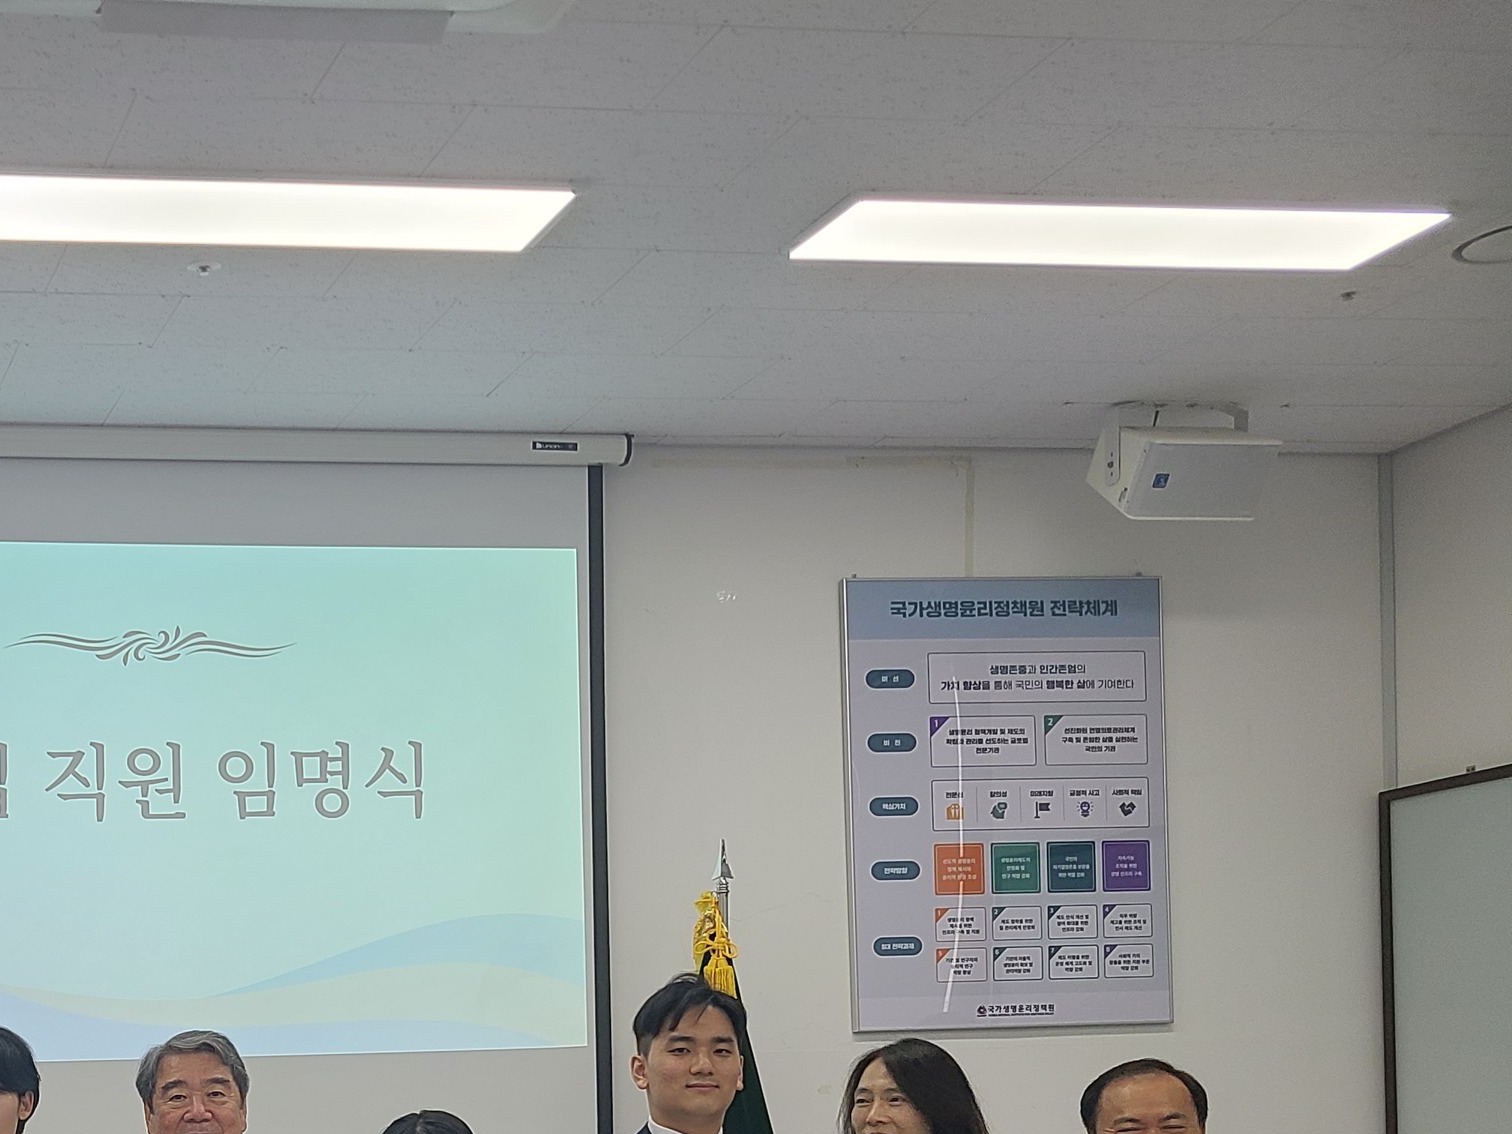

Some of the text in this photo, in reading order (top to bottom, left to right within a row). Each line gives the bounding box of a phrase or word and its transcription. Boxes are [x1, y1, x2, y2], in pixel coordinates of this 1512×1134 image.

[890, 600, 1118, 618] 국가생명윤리정책원 전략체계
[990, 664, 1086, 675] 생명존중과 인간존엄의
[940, 680, 1134, 691] 가치 향상을 통해 국민의 행복한 삶에 기여한다
[43, 740, 186, 823] 직원
[217, 739, 426, 821] 임명식
[988, 1004, 1054, 1014] 국가생명윤리정책원
